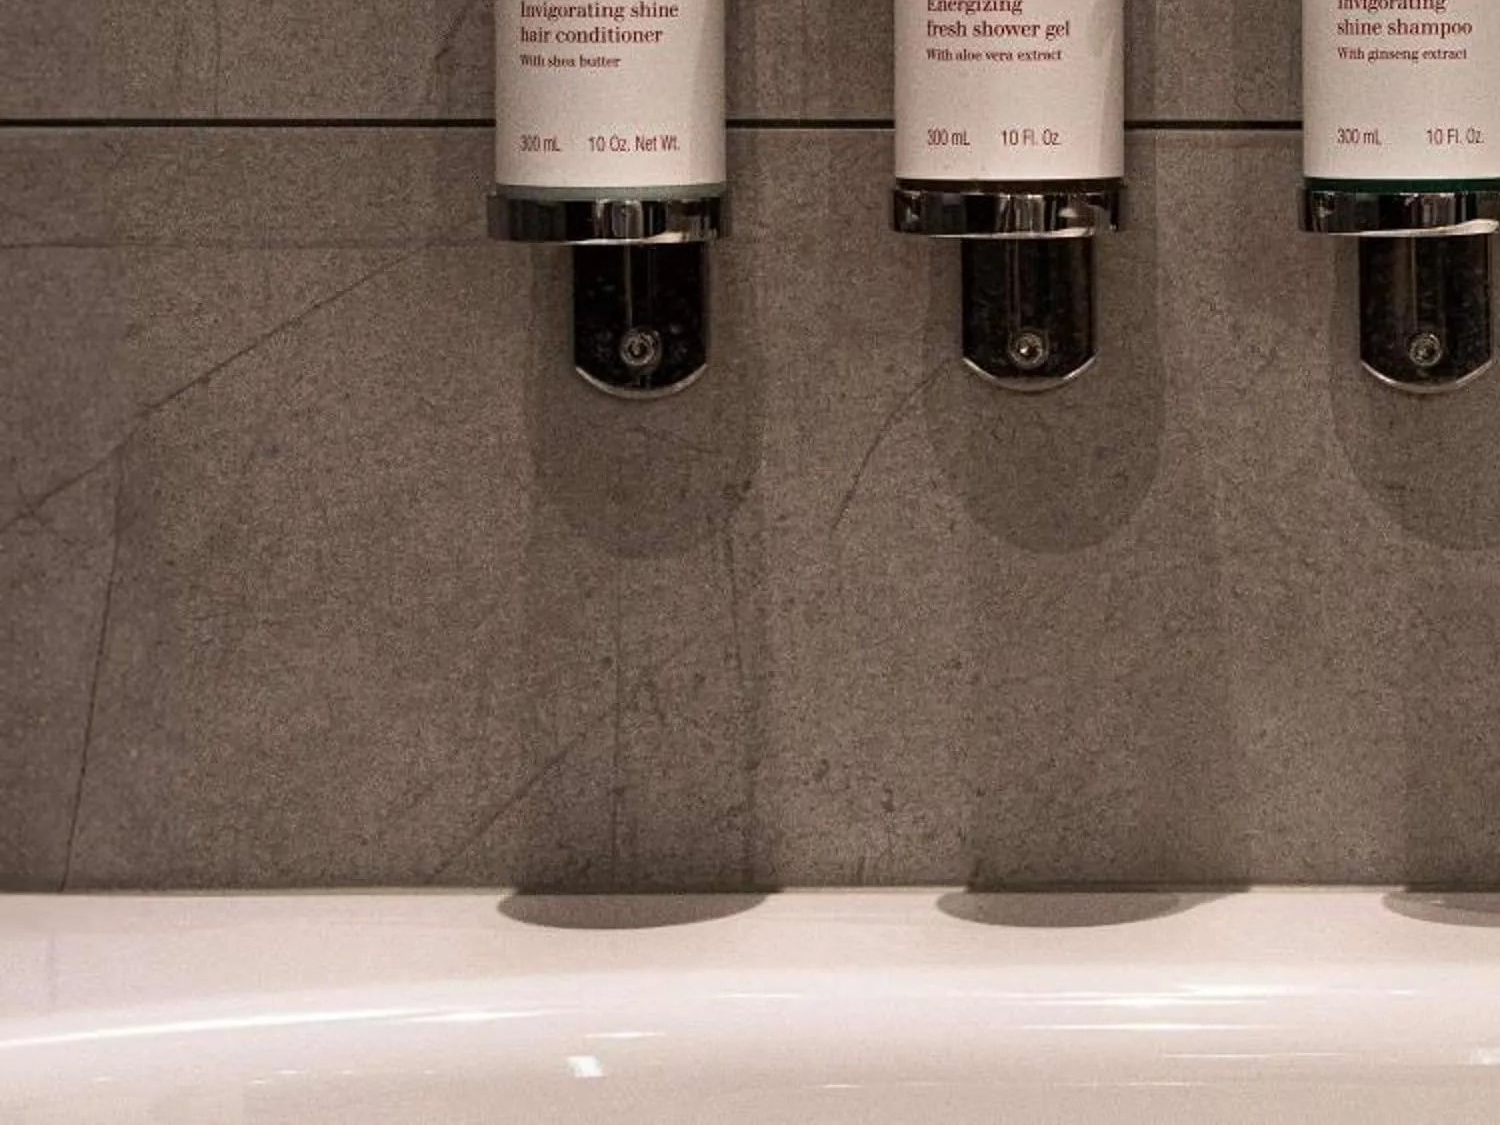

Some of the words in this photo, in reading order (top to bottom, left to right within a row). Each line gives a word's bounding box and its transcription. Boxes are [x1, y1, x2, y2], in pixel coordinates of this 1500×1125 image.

[520, 0, 625, 20] Invigorating
[630, 0, 679, 18] shine
[520, 26, 552, 43] hair
[555, 26, 663, 43] conditioner
[927, 21, 967, 38] fresh
[972, 21, 1040, 38] shower
[1045, 21, 1070, 41] gel
[1337, 20, 1383, 36] shine
[1387, 19, 1473, 39] shampoo
[519, 54, 545, 67] With
[547, 54, 576, 67] shea
[579, 54, 621, 67] butter
[927, 48, 953, 62] With
[955, 48, 983, 62] aloe
[985, 50, 1014, 62] vera
[1017, 49, 1063, 62] extract
[1338, 47, 1365, 61] With
[1368, 48, 1419, 63] ginseng
[1422, 47, 1467, 61] extract
[520, 135, 541, 152] 300
[543, 136, 562, 152] mL
[589, 135, 606, 152] 10
[609, 135, 631, 152] Oz.
[636, 136, 658, 151] Net
[660, 135, 680, 151] Wt.
[927, 128, 949, 146] 300
[952, 130, 970, 146] mL
[1002, 129, 1019, 146] 10
[1023, 129, 1038, 146] Fl.
[1337, 127, 1360, 145] 300
[1363, 128, 1382, 145] mL
[1427, 128, 1443, 145] 10
[1447, 128, 1463, 144] Fl.
[1466, 127, 1485, 144] Oz.
